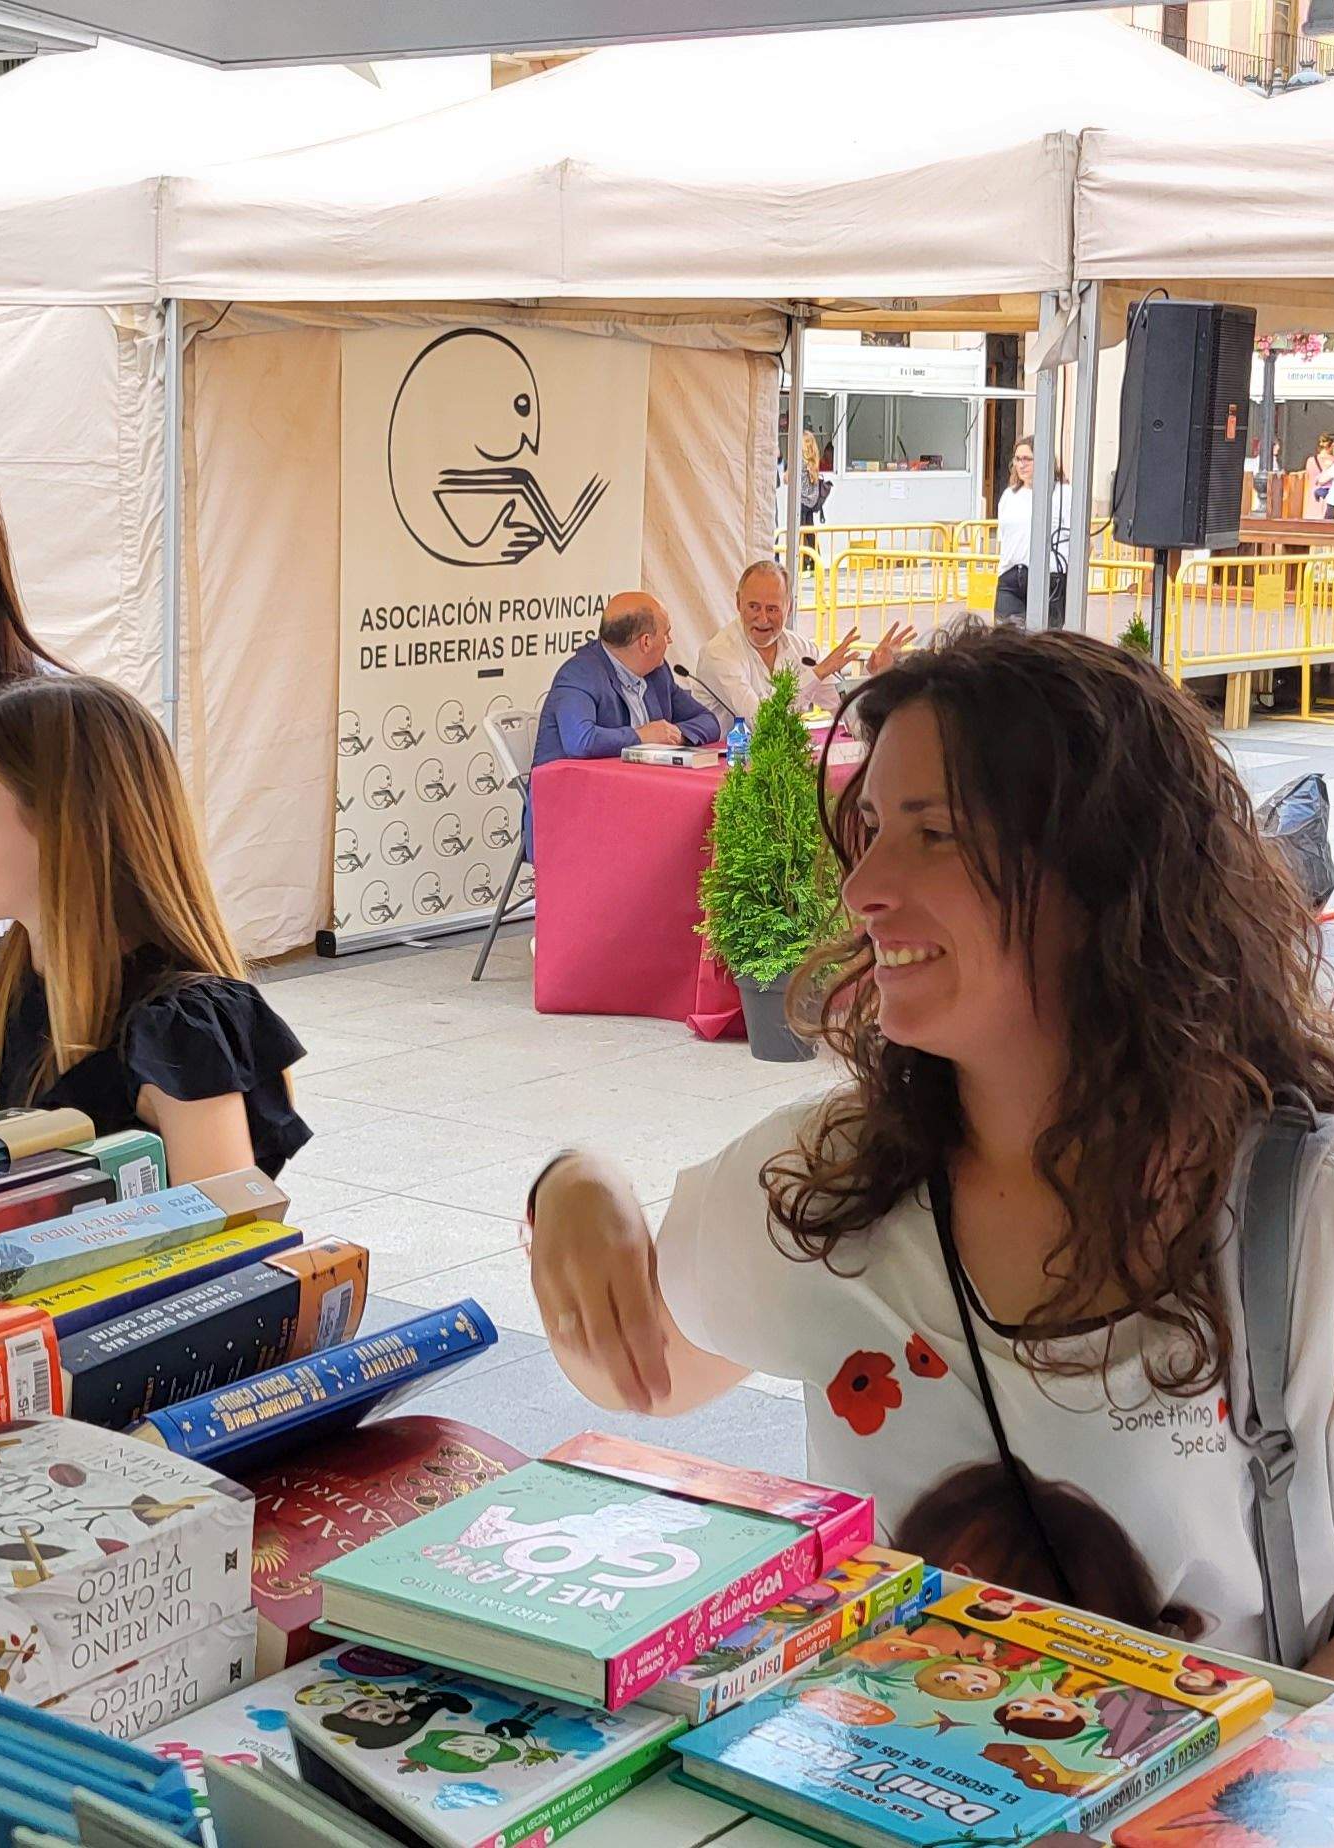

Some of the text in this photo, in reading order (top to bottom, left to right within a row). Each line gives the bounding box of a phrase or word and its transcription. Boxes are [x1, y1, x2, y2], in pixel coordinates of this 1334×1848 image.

[360, 596, 491, 632] ASOCIACIÓN
[360, 643, 388, 669] DE
[394, 634, 505, 667] LIBRERIAS
[511, 633, 539, 658] DE
[88, 1284, 227, 1343] ESTRELLAS QUE CONTAR
[98, 1290, 243, 1353] CUANDO NO QUEDEN MÁS
[356, 1335, 402, 1361] BRANDON
[360, 1347, 419, 1380] SANDERSON
[233, 1391, 304, 1428] PARA SOBREVIVIR
[1108, 1405, 1213, 1431] Something
[1171, 1435, 1227, 1457] Special
[458, 1504, 703, 1590] GOA
[77, 1544, 182, 1603] Y FUEGO
[420, 1543, 624, 1612] ME LLAMO
[71, 1567, 192, 1641] DE CARNE
[709, 1570, 784, 1629] ME LLAMO GOA
[71, 1600, 191, 1669] UN REINO
[794, 1634, 831, 1661] La gran
[637, 1657, 664, 1679] TIRADO
[720, 1656, 781, 1704] Osito Tito
[89, 1658, 189, 1723] Y FUEGO
[171, 1680, 198, 1708] DE
[879, 1739, 908, 1761] LOS
[911, 1756, 931, 1771] DE
[848, 1762, 897, 1784] y
[931, 1766, 1000, 1798] SECRETO
[1078, 1731, 1217, 1832] SECRETO DE LOS DINOSAURIOS
[527, 1807, 551, 1832] VECINA
[552, 1799, 566, 1818] MUY
[568, 1784, 592, 1810] MÁGICA
[875, 1774, 1000, 1827] Dani
[888, 1805, 925, 1822] Las
[1003, 1791, 1021, 1805] EL
